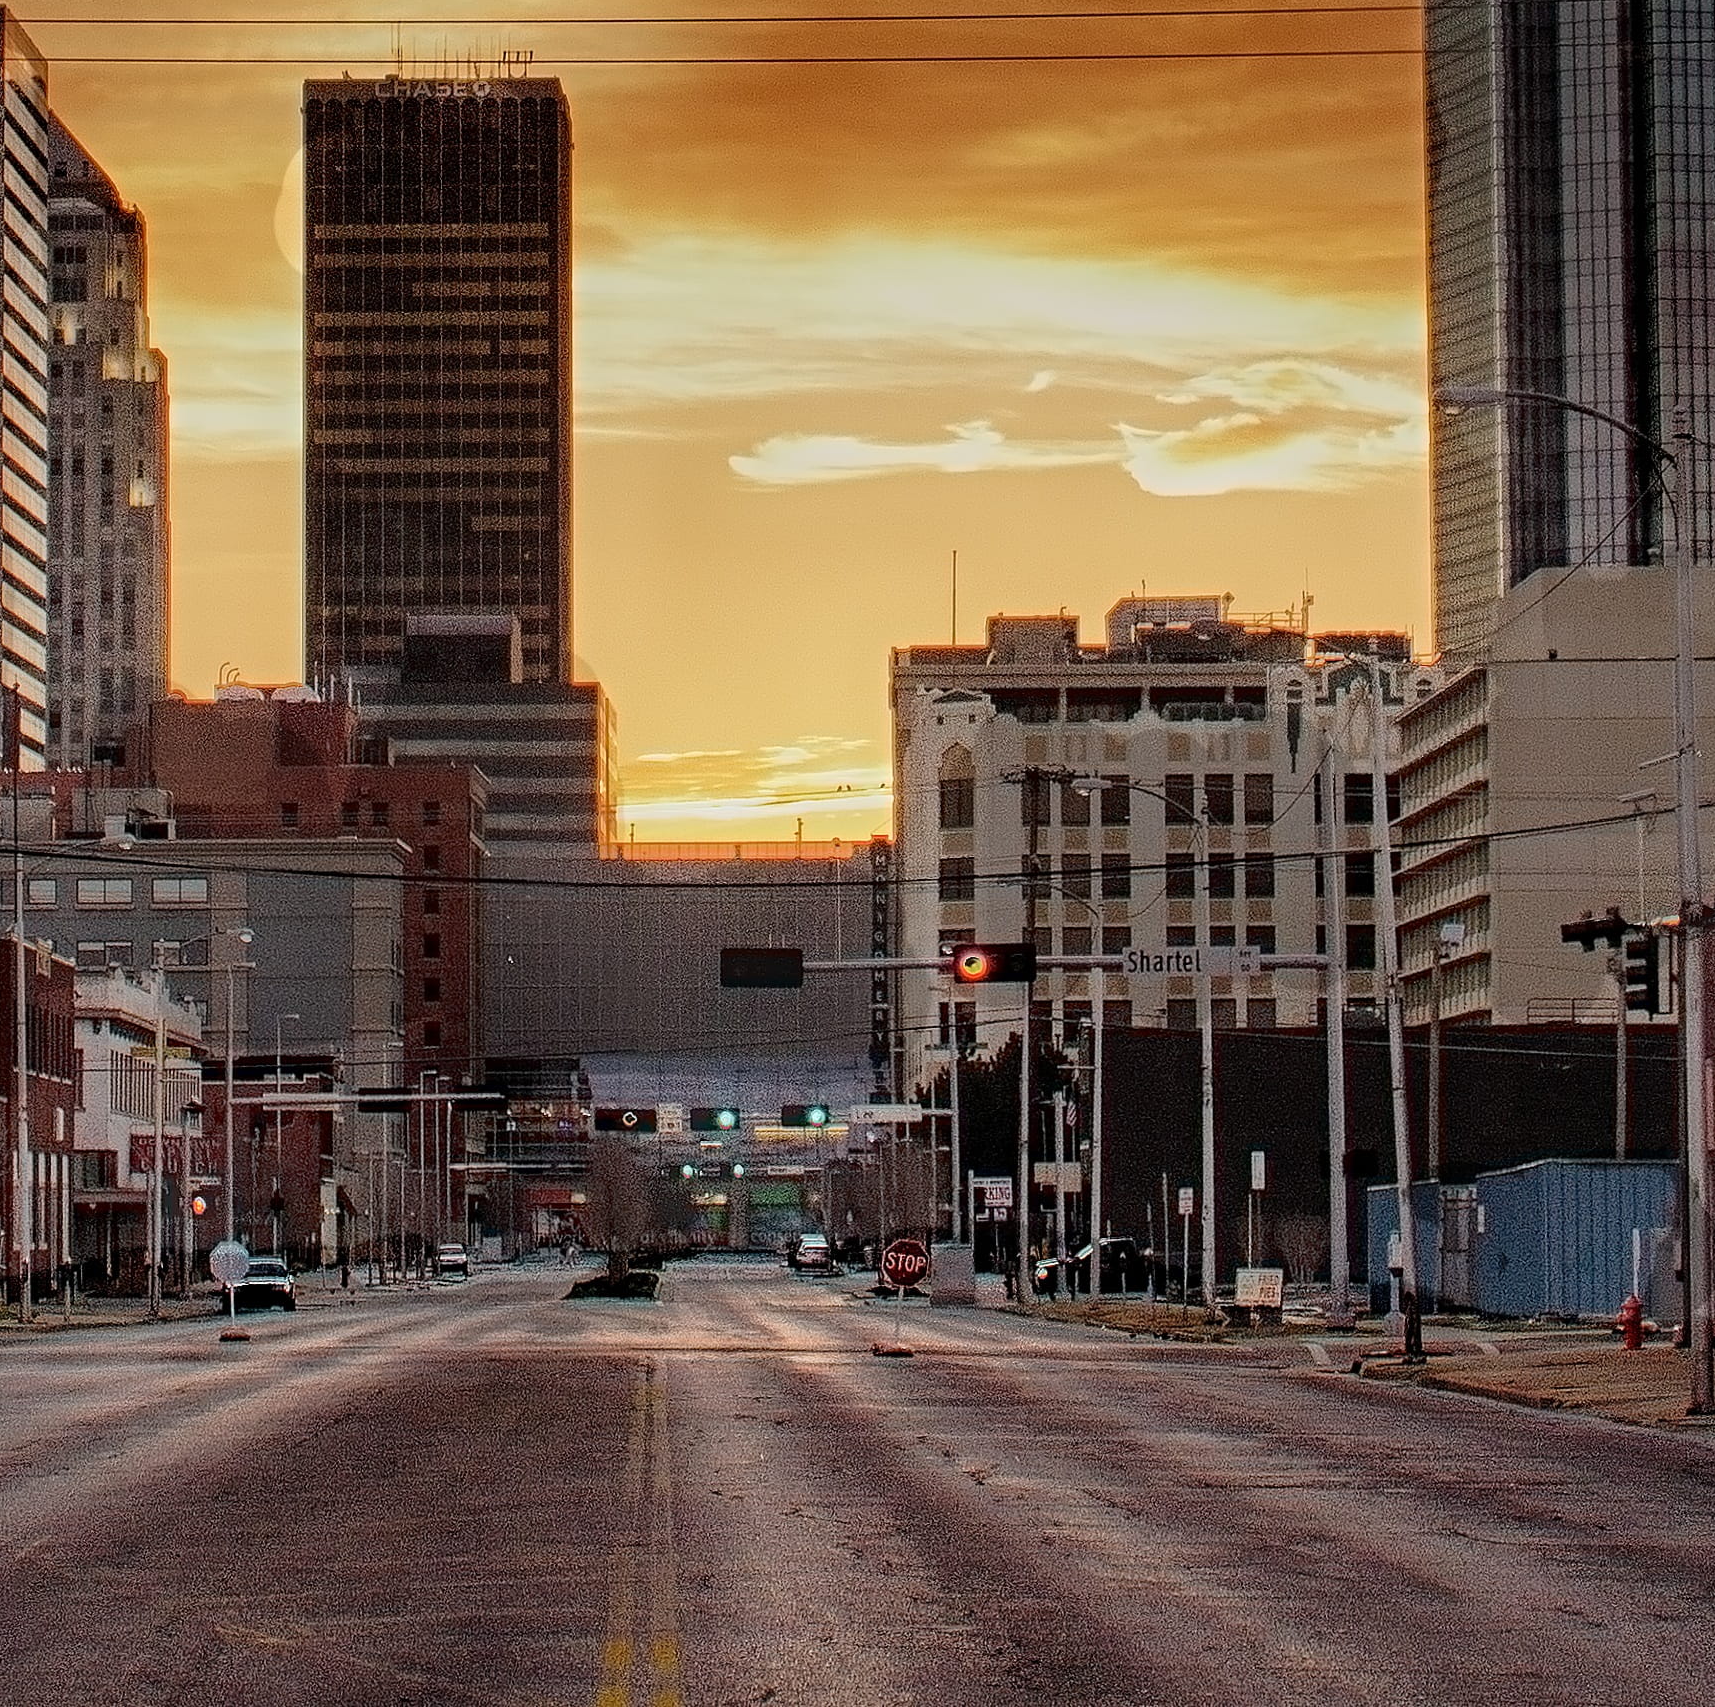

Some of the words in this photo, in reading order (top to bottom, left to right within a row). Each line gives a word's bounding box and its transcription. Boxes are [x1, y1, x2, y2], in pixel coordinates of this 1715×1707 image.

[375, 81, 469, 97] CHASE
[1128, 949, 1201, 973] Shartel
[886, 1253, 926, 1273] STOP
